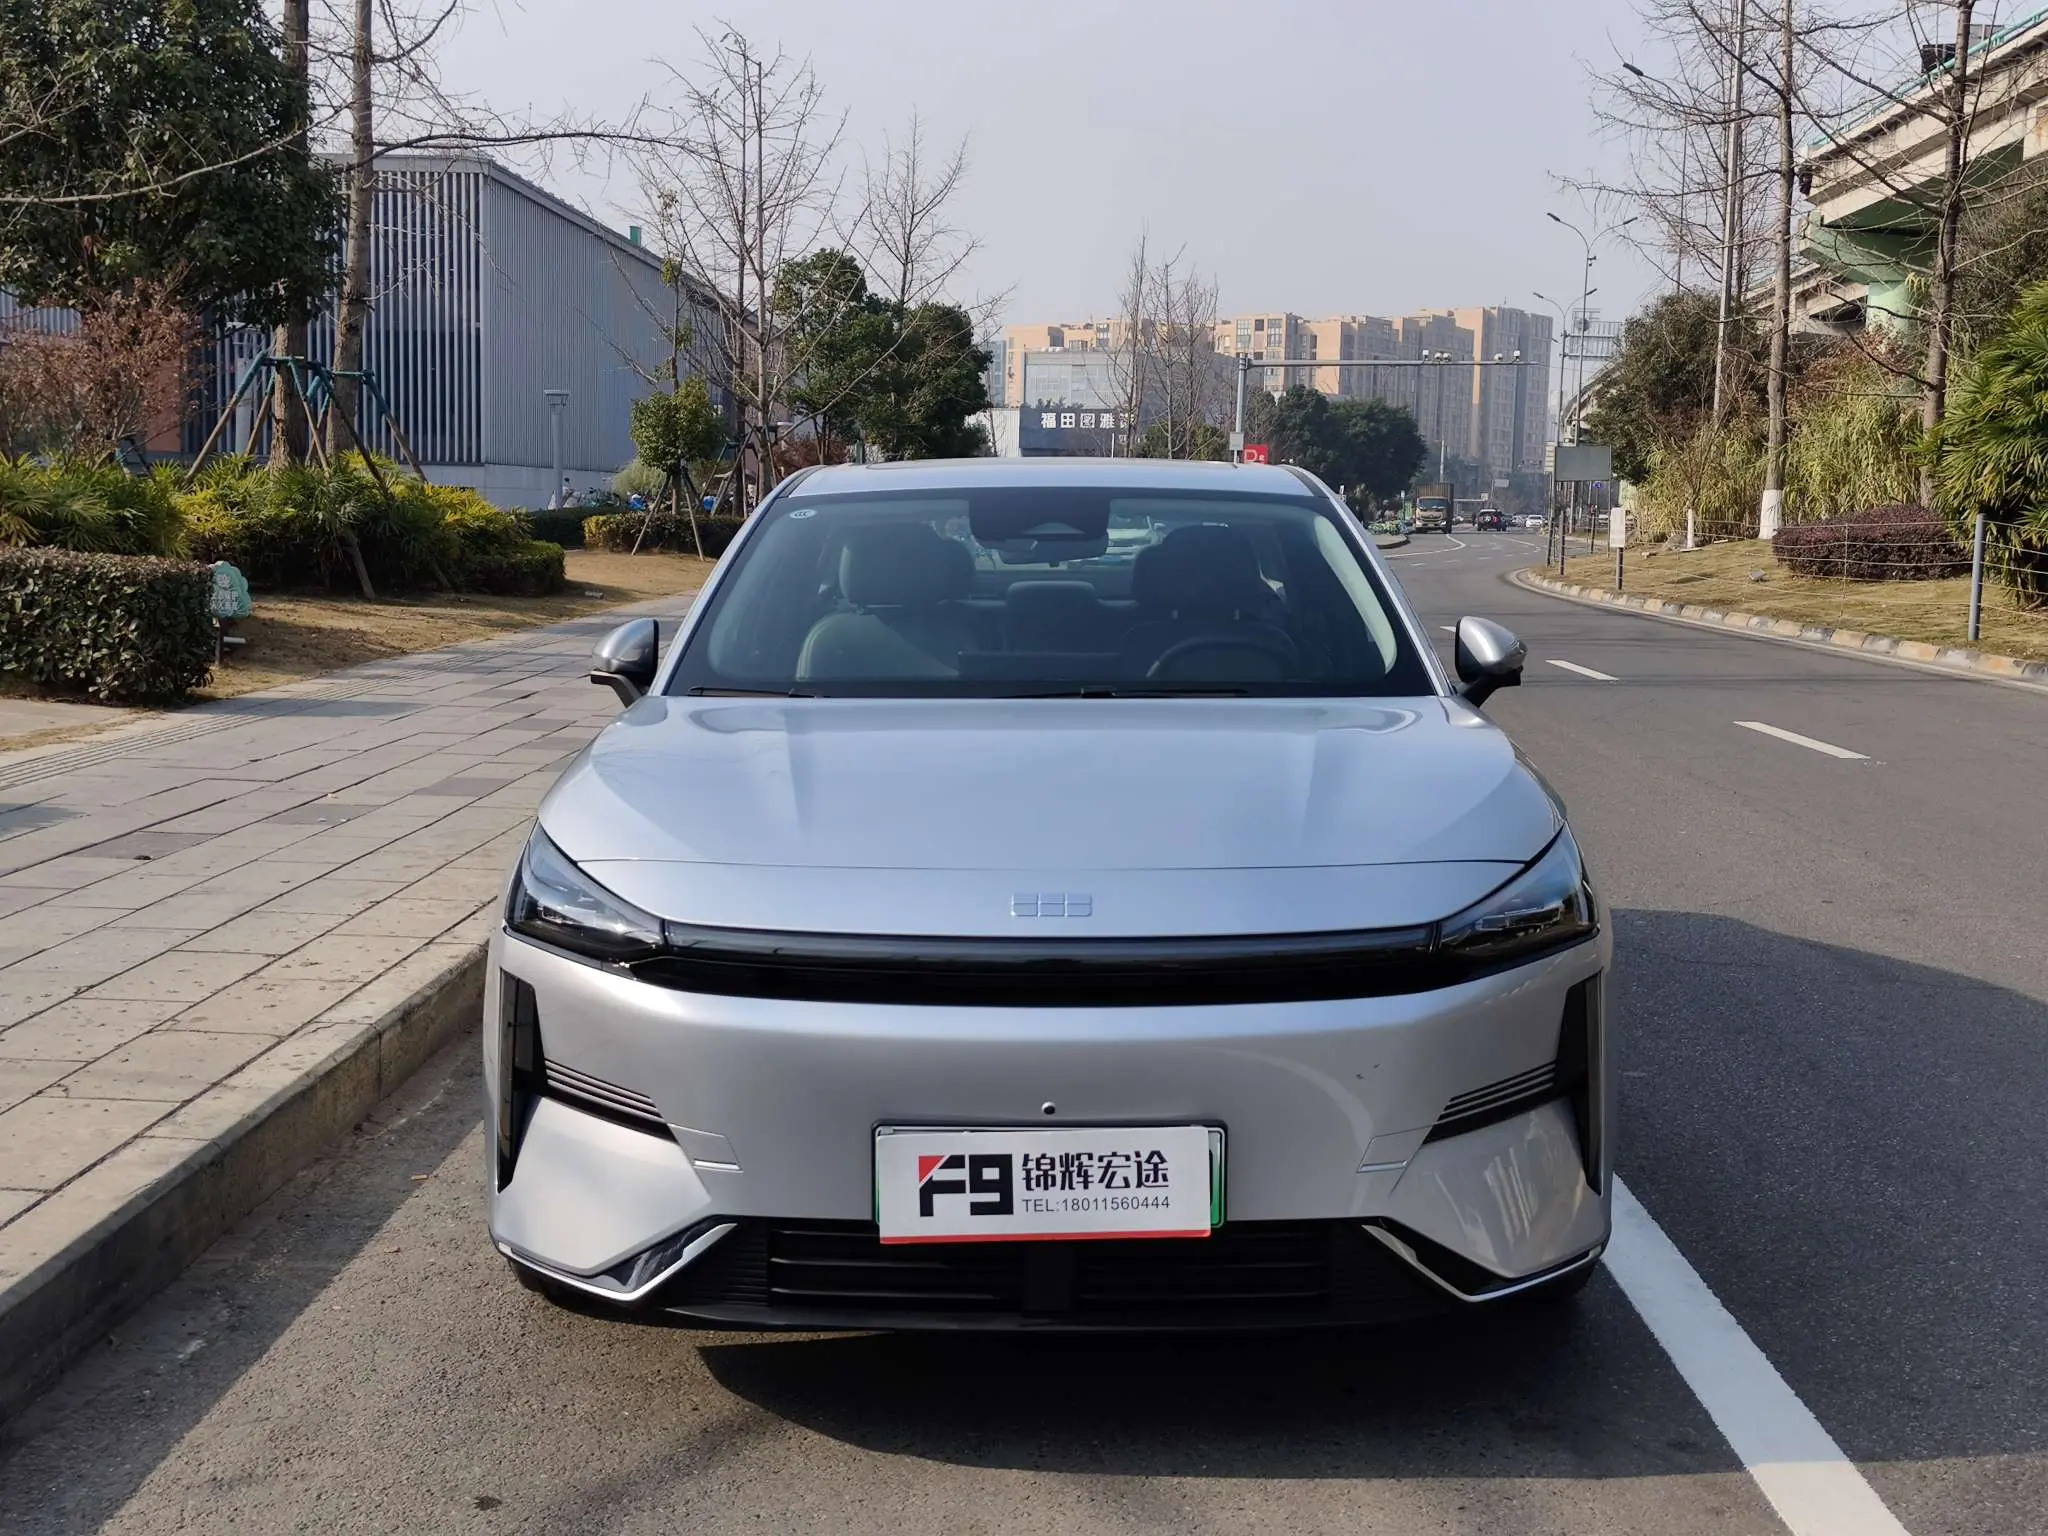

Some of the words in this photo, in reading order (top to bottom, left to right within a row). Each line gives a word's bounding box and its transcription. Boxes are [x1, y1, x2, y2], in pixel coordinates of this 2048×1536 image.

[918, 1154, 1014, 1217] F9
[1022, 1150, 1169, 1191] 锦辉宏途
[1022, 1195, 1170, 1213] TEL:18011560444
